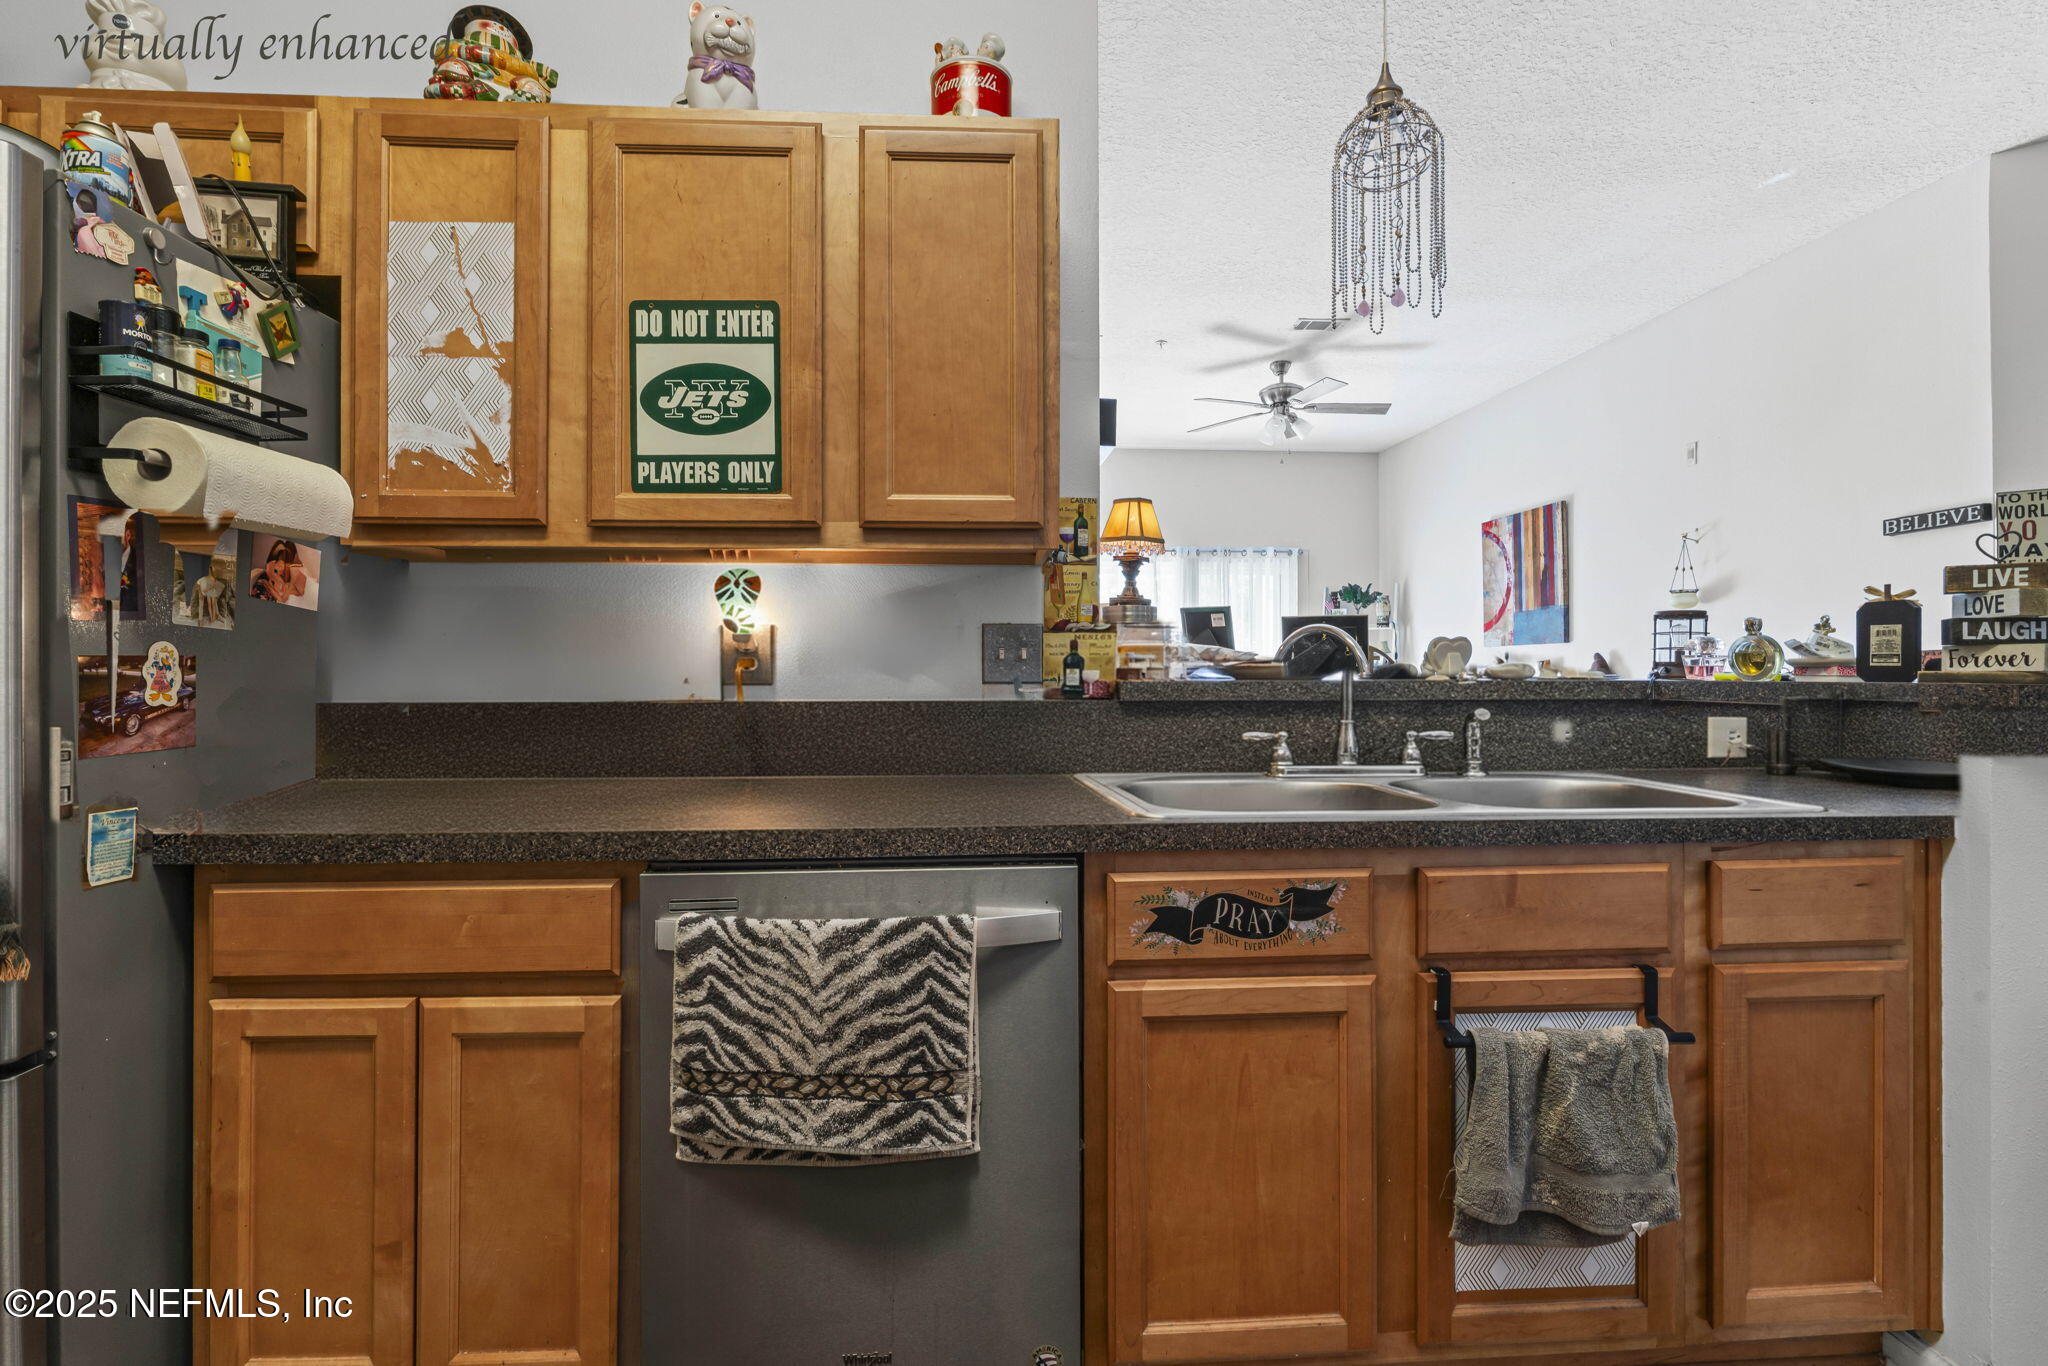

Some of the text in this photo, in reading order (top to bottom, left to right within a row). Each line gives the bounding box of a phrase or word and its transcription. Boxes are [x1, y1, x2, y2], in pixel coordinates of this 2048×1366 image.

[635, 309, 775, 338] DO NOT ENTER
[657, 386, 750, 409] JETS
[637, 461, 775, 484] PLAYERS ONLY
[1998, 493, 2021, 504] TO
[1885, 505, 1981, 534] BELIEVE
[1972, 567, 2030, 588] LIVE
[1964, 594, 2005, 616] LOVE
[1962, 621, 2047, 640] LAUGH
[1949, 649, 2036, 668] Forever
[1247, 889, 1274, 903] INSTEAD
[1214, 897, 1278, 934] PRAY
[1213, 928, 1293, 951] ABOUT EVERYTHING
